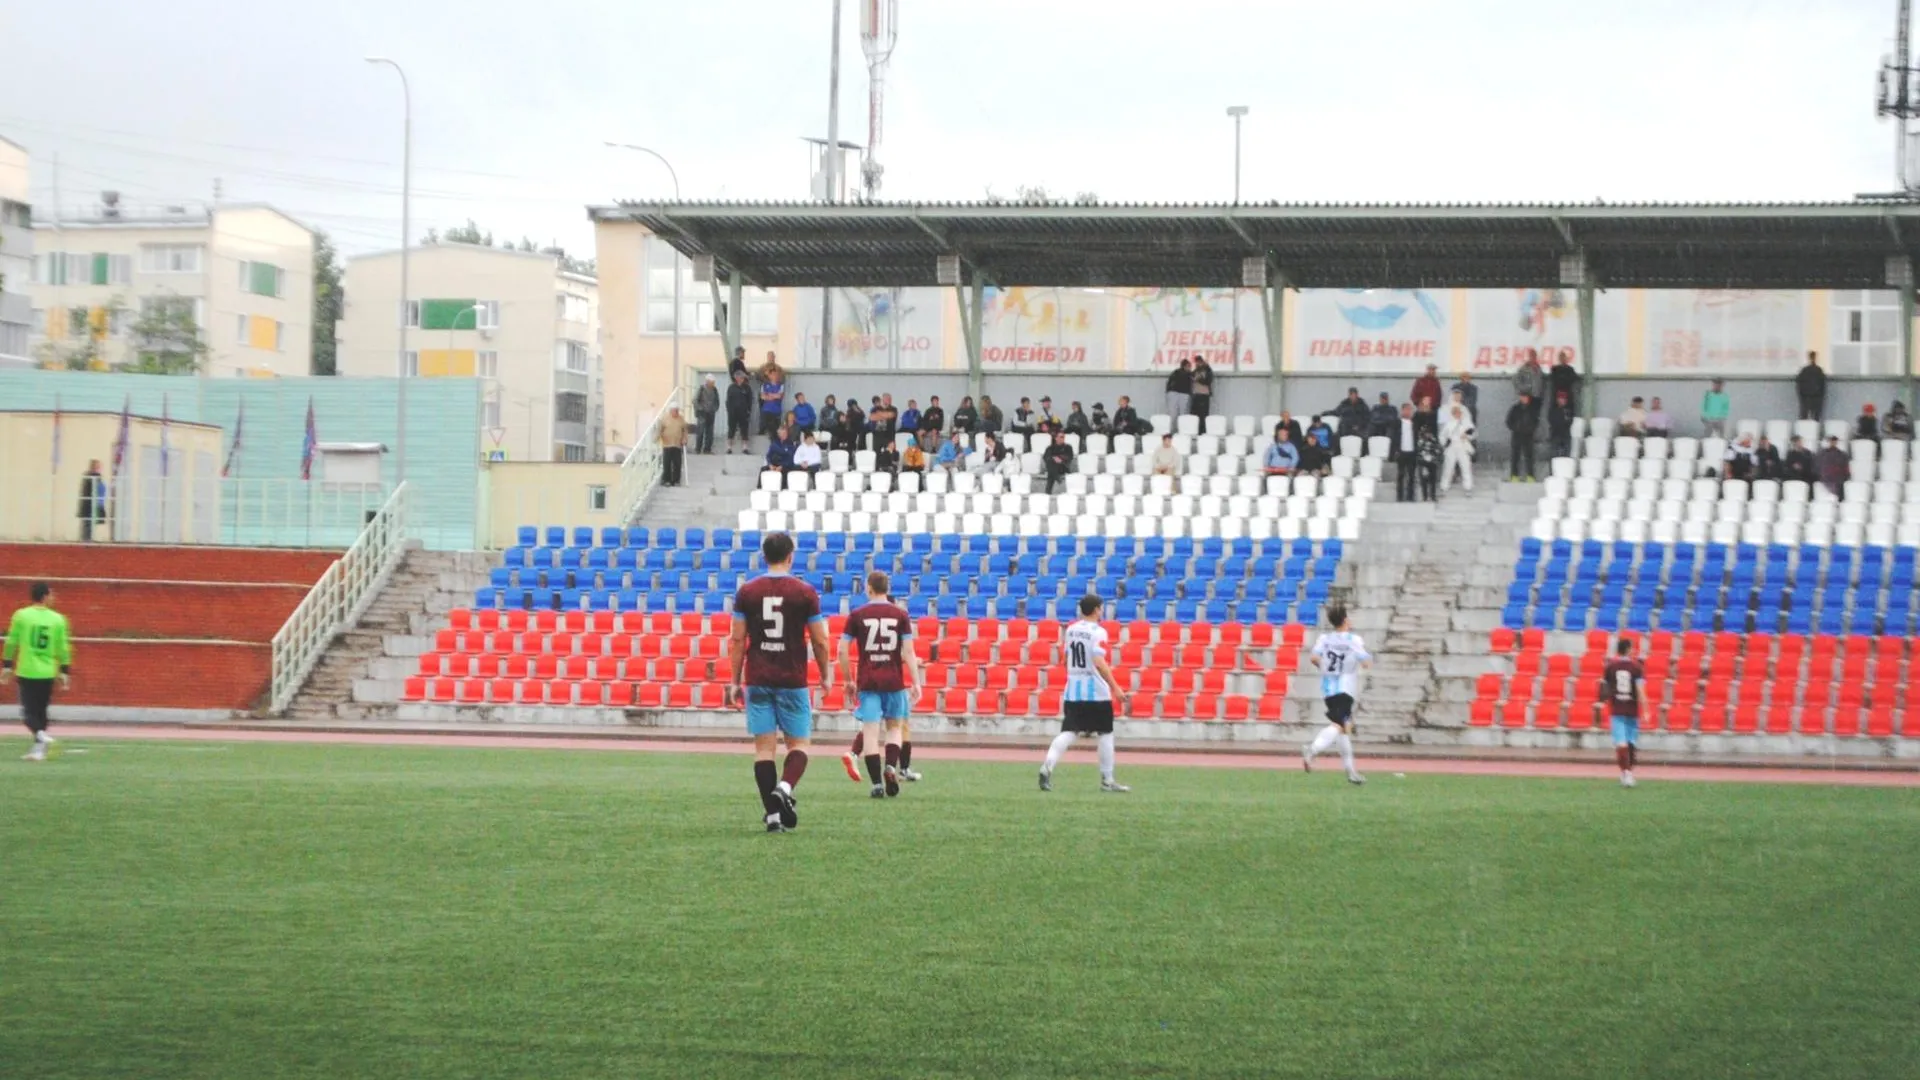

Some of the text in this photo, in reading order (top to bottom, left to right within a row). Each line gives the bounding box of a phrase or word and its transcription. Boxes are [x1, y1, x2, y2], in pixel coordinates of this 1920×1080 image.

[1310, 340, 1435, 356] ПЛАВАНИЕ
[1474, 346, 1575, 367] ДЗЮДО
[763, 597, 784, 638] 5
[863, 618, 898, 651] 25
[1070, 641, 1086, 668] 10
